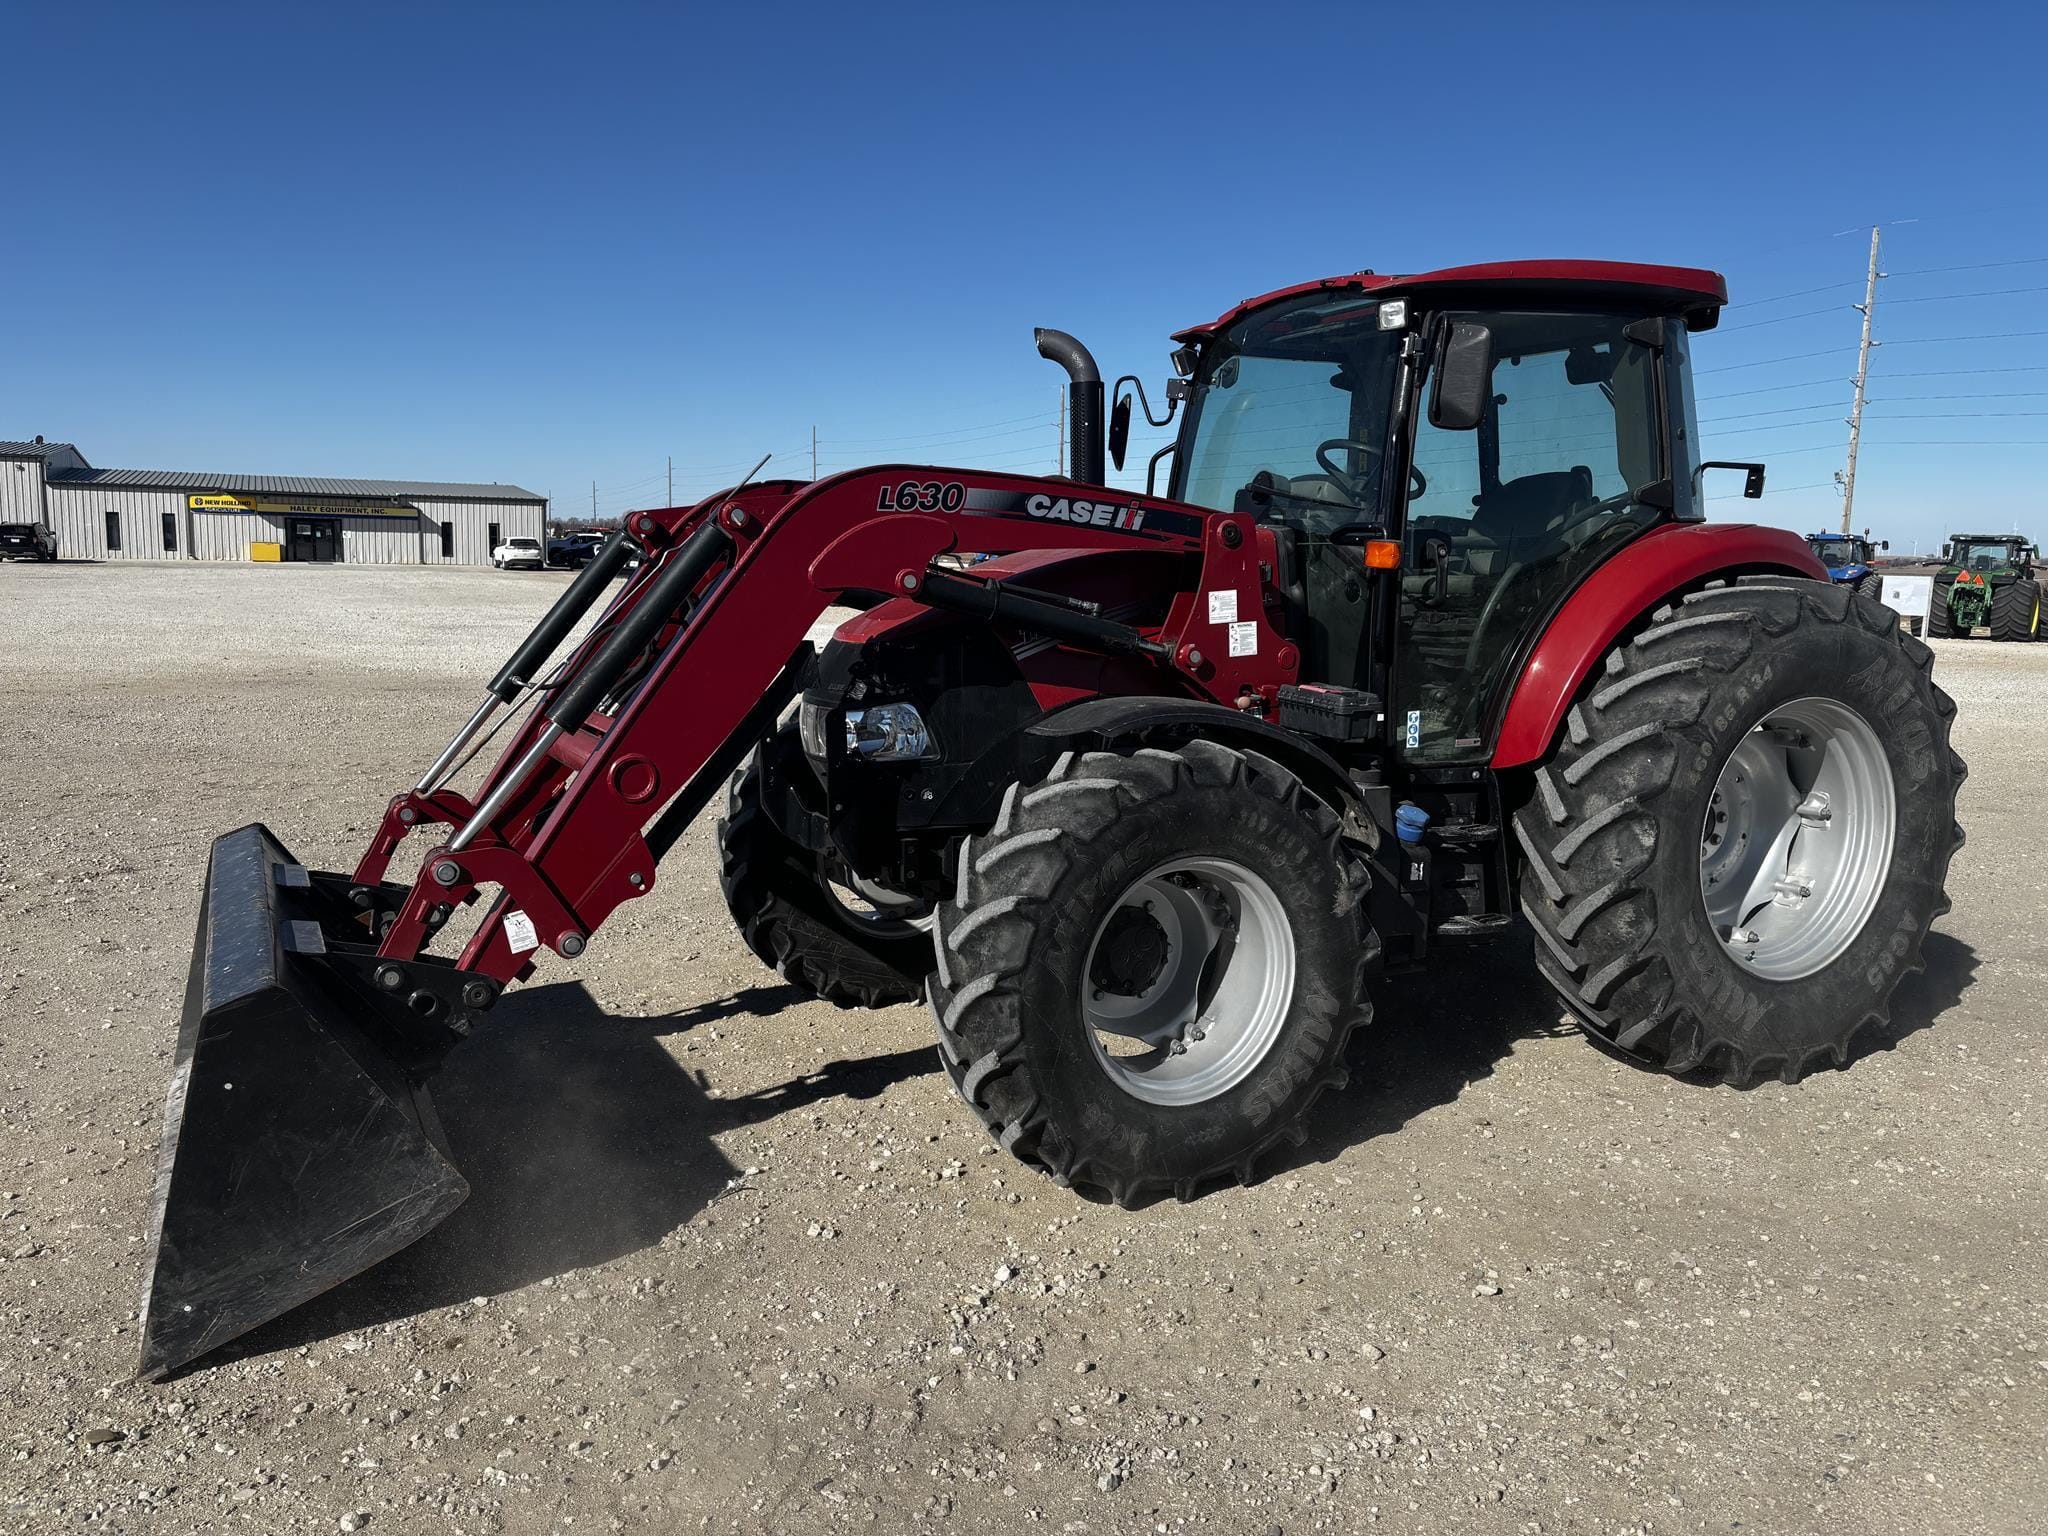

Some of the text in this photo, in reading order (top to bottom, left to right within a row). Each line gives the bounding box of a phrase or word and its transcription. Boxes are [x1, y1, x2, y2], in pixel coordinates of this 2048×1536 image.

[320, 507, 369, 515] EQUIPMENT,
[876, 480, 967, 513] L630
[1026, 494, 1114, 527] CASE
